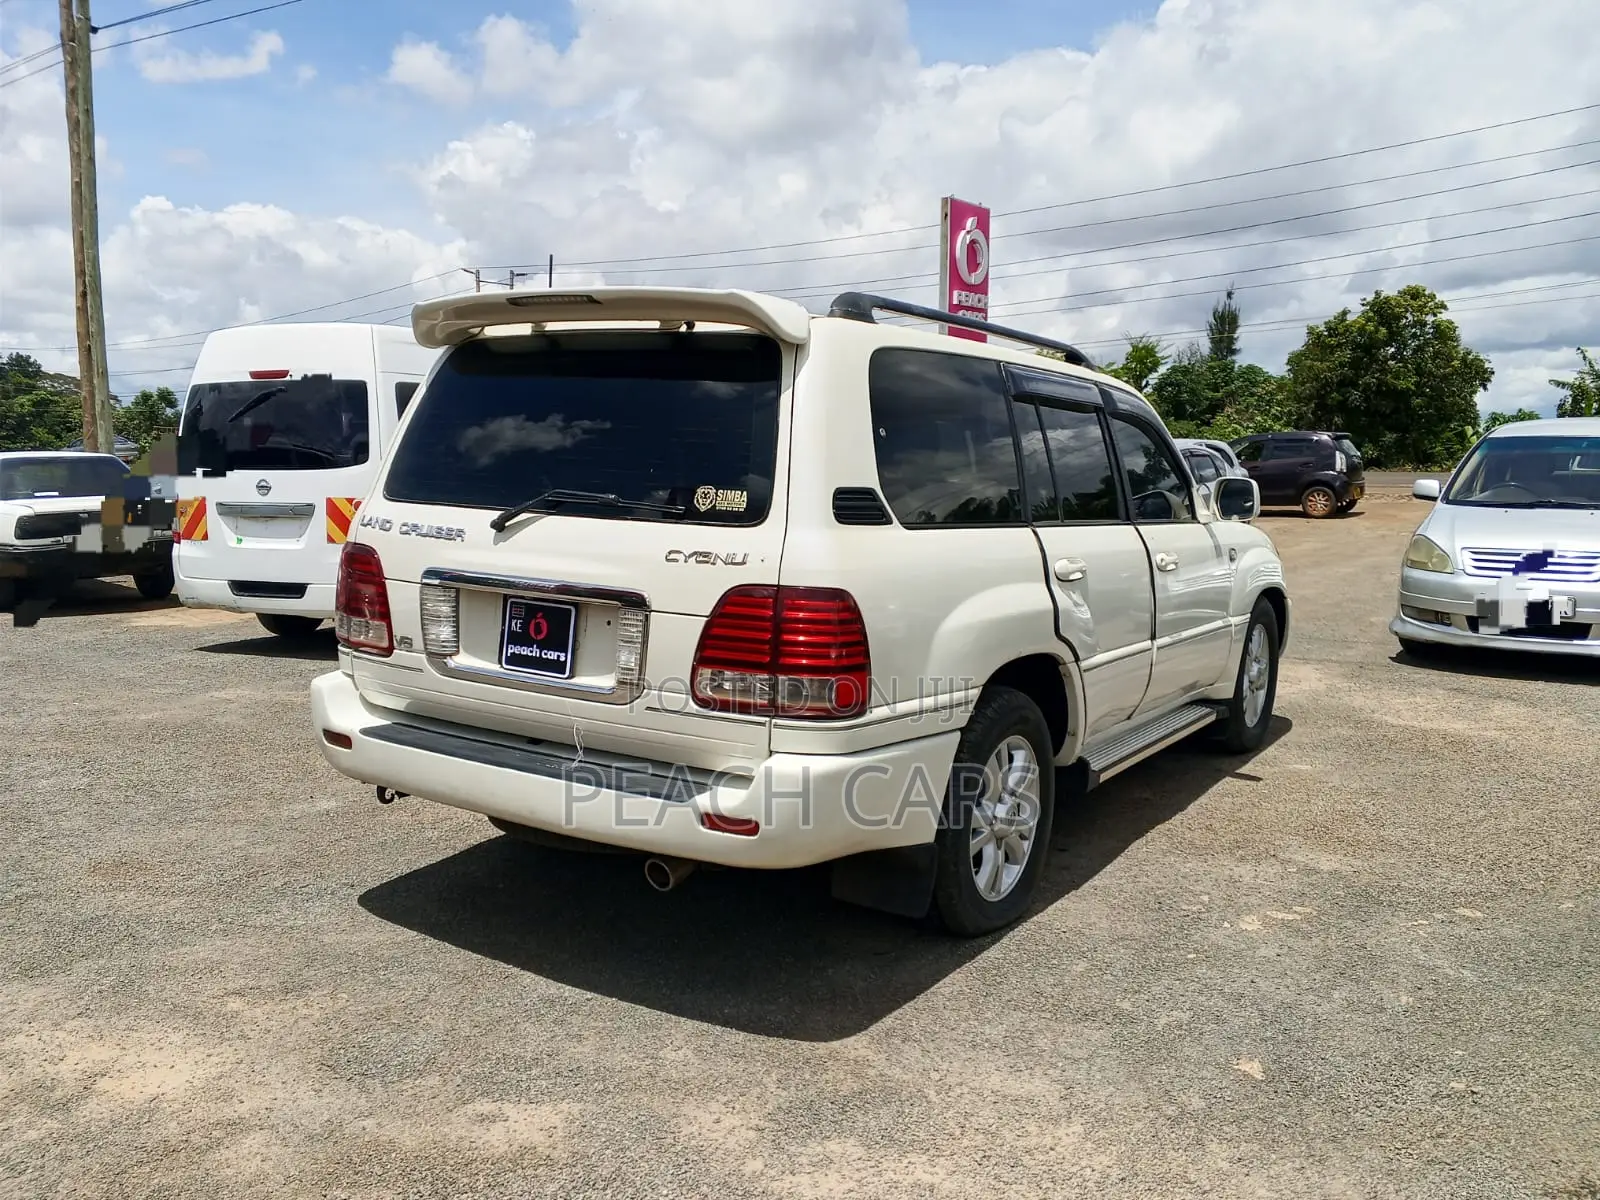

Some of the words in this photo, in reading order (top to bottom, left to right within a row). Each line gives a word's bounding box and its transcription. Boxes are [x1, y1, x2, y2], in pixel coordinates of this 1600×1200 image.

[717, 490, 747, 502] SIMBA
[360, 514, 393, 532] LAND
[399, 521, 466, 542] CRUISER
[511, 619, 523, 632] KE
[507, 644, 540, 657] peach
[541, 649, 566, 661] cars
